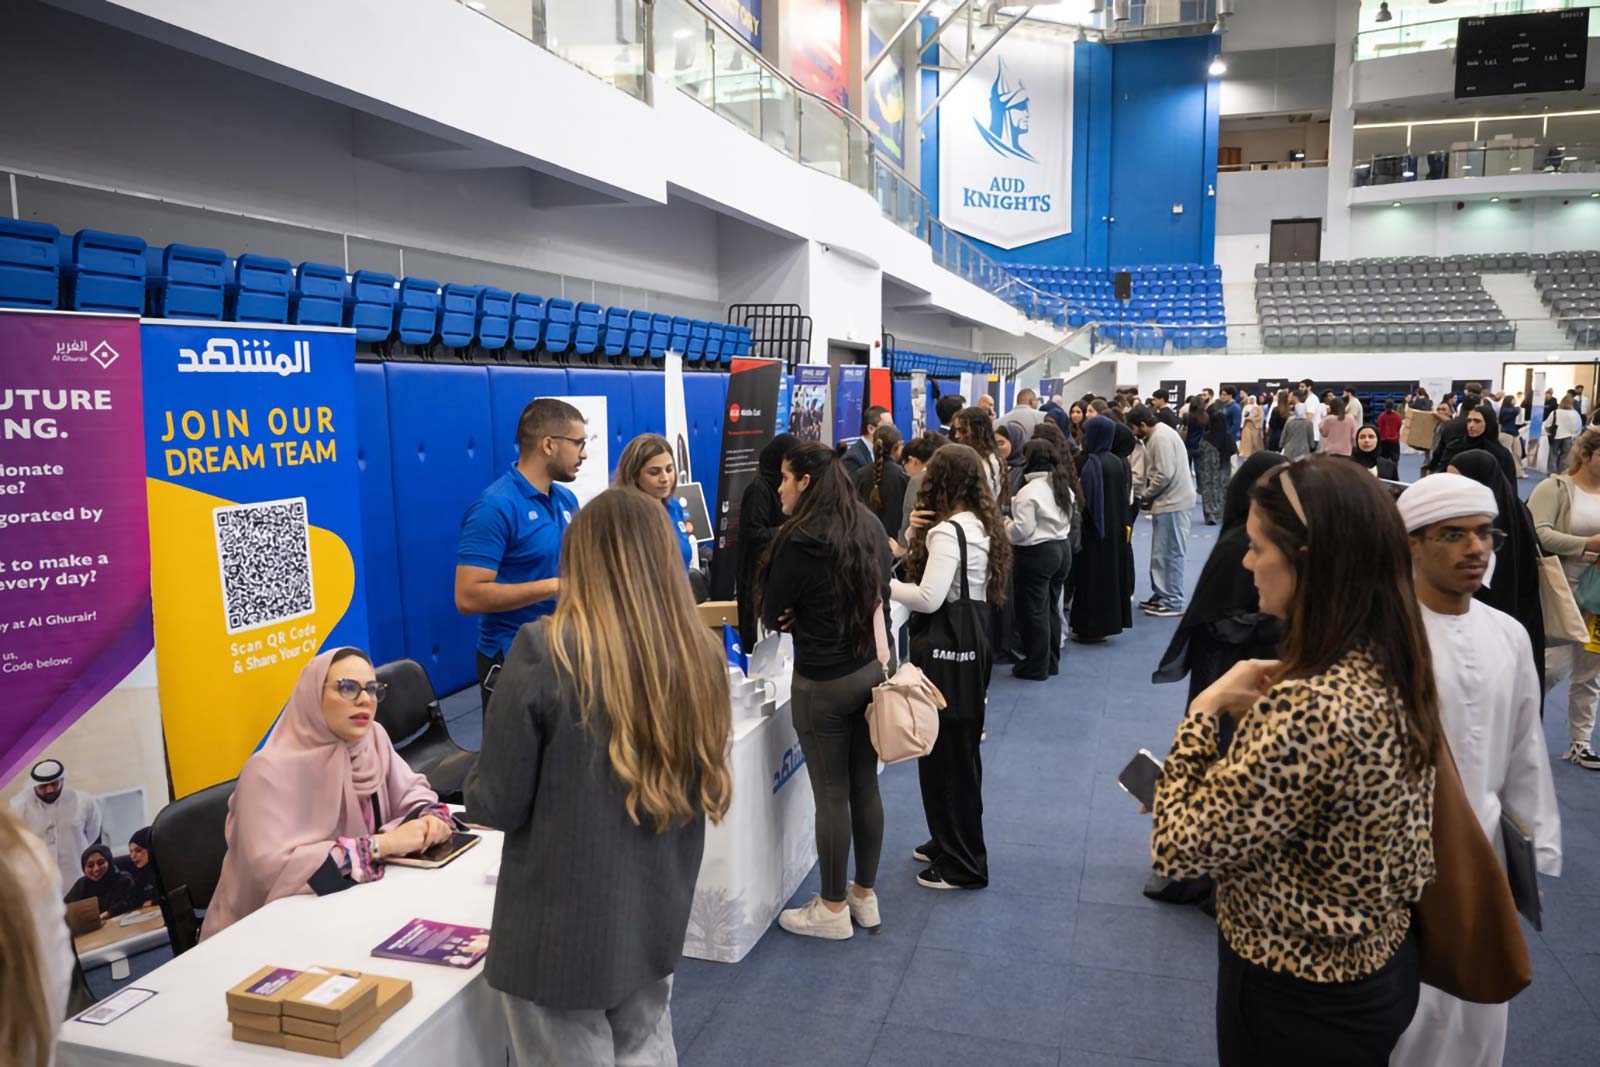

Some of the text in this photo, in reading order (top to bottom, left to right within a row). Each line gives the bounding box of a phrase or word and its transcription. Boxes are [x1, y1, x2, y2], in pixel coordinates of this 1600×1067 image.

[989, 176, 1025, 193] AUD
[963, 187, 1051, 213] KNIGHTS
[55, 339, 88, 354] الغرير
[177, 337, 311, 377] المشهد
[4, 418, 69, 440] NG.
[161, 406, 335, 442] JOIN OUR
[164, 438, 337, 477] DREAM TEAM
[0, 463, 64, 477] ionate
[80, 506, 103, 523] by
[11, 559, 33, 572] to
[39, 553, 93, 570] make
[97, 554, 109, 565] a
[55, 569, 97, 587] day?
[12, 619, 26, 630] at
[28, 616, 43, 628] Al
[45, 610, 97, 626] Ghurair!
[230, 624, 316, 657] Scan QR Code
[233, 638, 317, 674] & Share Your CV
[2, 661, 34, 673] Code
